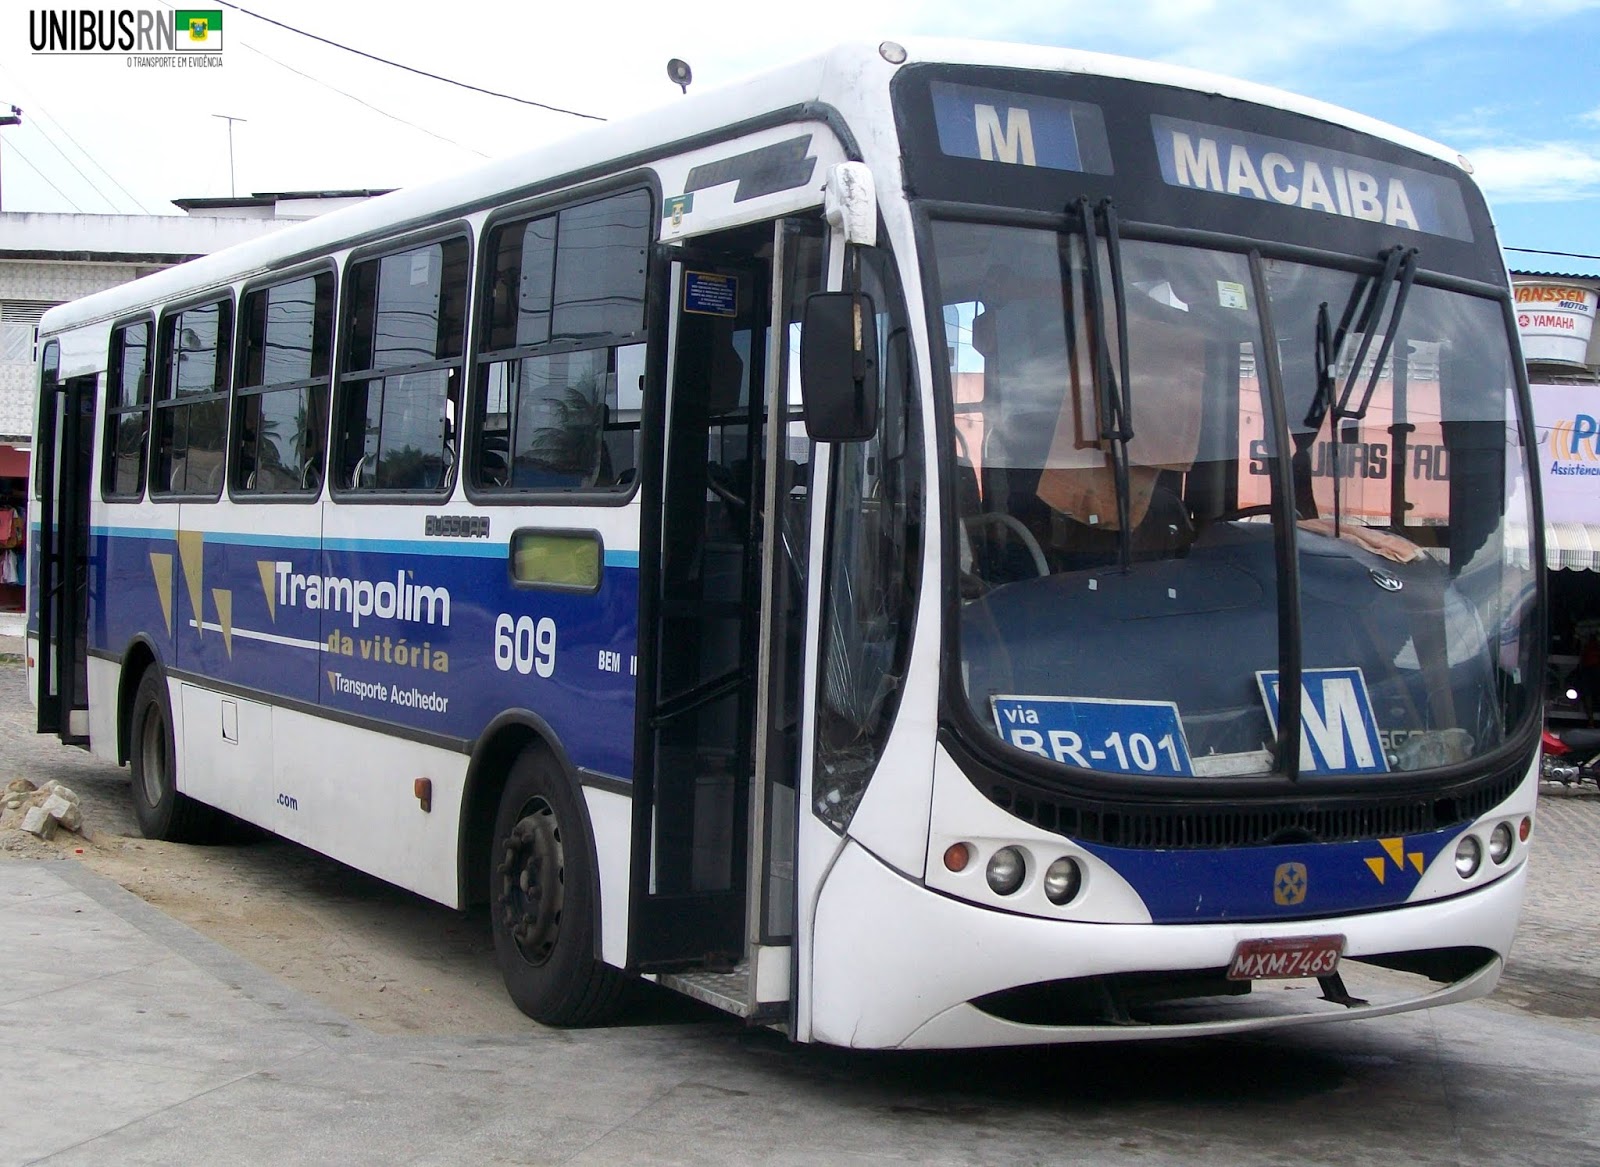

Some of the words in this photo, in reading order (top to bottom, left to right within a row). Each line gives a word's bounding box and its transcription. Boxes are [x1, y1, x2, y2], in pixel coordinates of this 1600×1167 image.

[974, 104, 1036, 167] M
[1172, 131, 1420, 231] MACAIBA
[1533, 314, 1575, 330] YAMAHA
[1558, 300, 1589, 312] MOTOS
[425, 515, 490, 538] BUSSCAR
[276, 561, 450, 628] Trampolim
[328, 629, 353, 655] da
[360, 637, 449, 673] vitória
[494, 613, 556, 678] 609
[598, 649, 620, 673] BEM
[335, 672, 387, 701] Transporte
[391, 684, 448, 712] Acolhedor
[1003, 704, 1039, 724] via
[1271, 678, 1376, 770] M
[1010, 729, 1182, 772] BR-101
[276, 793, 298, 811] .com
